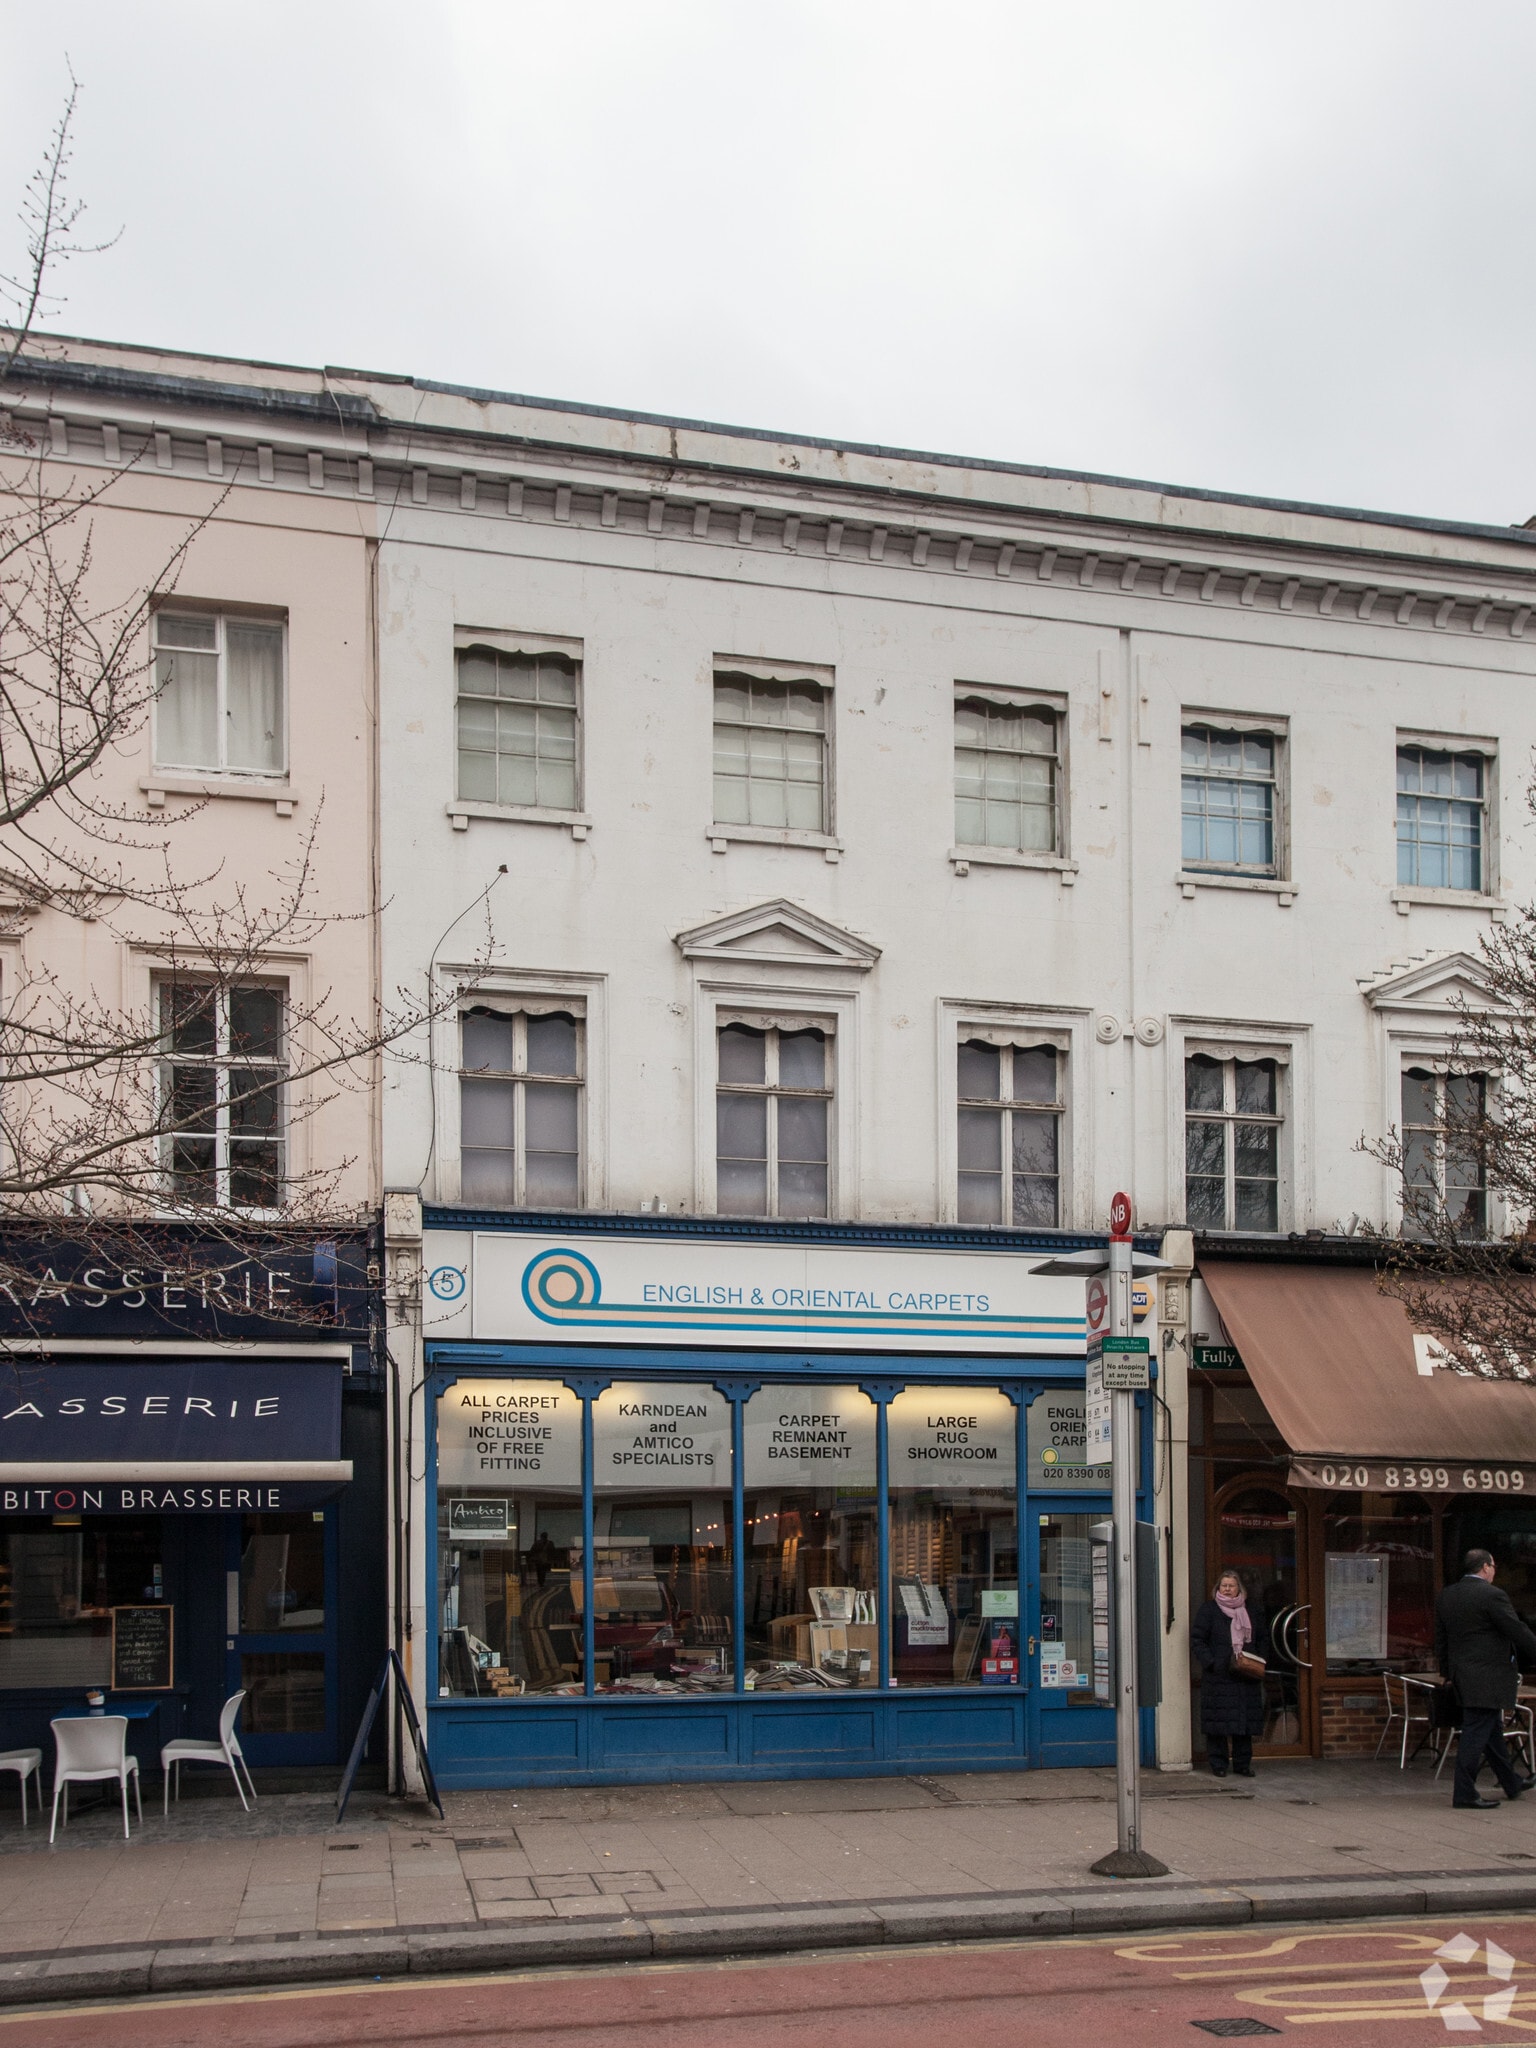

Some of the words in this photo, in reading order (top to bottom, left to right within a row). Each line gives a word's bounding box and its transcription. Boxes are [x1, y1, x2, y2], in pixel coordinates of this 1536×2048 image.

[1111, 1204, 1126, 1224] NB
[441, 1273, 454, 1293] 5
[643, 1284, 743, 1305] ENGLISH
[750, 1288, 765, 1306] &
[772, 1288, 881, 1309] ORIENTAL
[888, 1292, 990, 1312] CARPETS
[1202, 1350, 1236, 1367] Fully
[1118, 1363, 1146, 1372] stopping
[1105, 1380, 1127, 1388] except
[461, 1395, 491, 1407] ALL
[496, 1396, 559, 1408] CARPET
[2, 1397, 280, 1419] ASSERIE
[619, 1404, 707, 1417] KARNDEAN
[482, 1411, 539, 1423] PRICES
[779, 1415, 840, 1427] CARPET
[927, 1417, 977, 1428] LARGE
[469, 1426, 552, 1439] INCLUSIVE
[650, 1421, 677, 1433] and
[633, 1437, 694, 1449] AMTICO
[773, 1431, 847, 1443] REMNANT
[937, 1432, 968, 1443] RUG
[477, 1442, 499, 1454] OF
[503, 1442, 544, 1454] FREE
[768, 1447, 852, 1459] BASEMENT
[908, 1447, 997, 1459] SHOWROOM
[480, 1457, 541, 1470] FITTING
[612, 1452, 714, 1465] SPECIALISTS
[1043, 1468, 1063, 1479] 020
[1067, 1468, 1093, 1479] 8390
[1322, 1465, 1369, 1487] 020
[1385, 1467, 1449, 1488] 8399
[1463, 1469, 1524, 1490] 6909
[4, 1490, 102, 1509] BITON
[121, 1489, 280, 1508] BRASSERIE
[454, 1504, 504, 1518] Amtico
